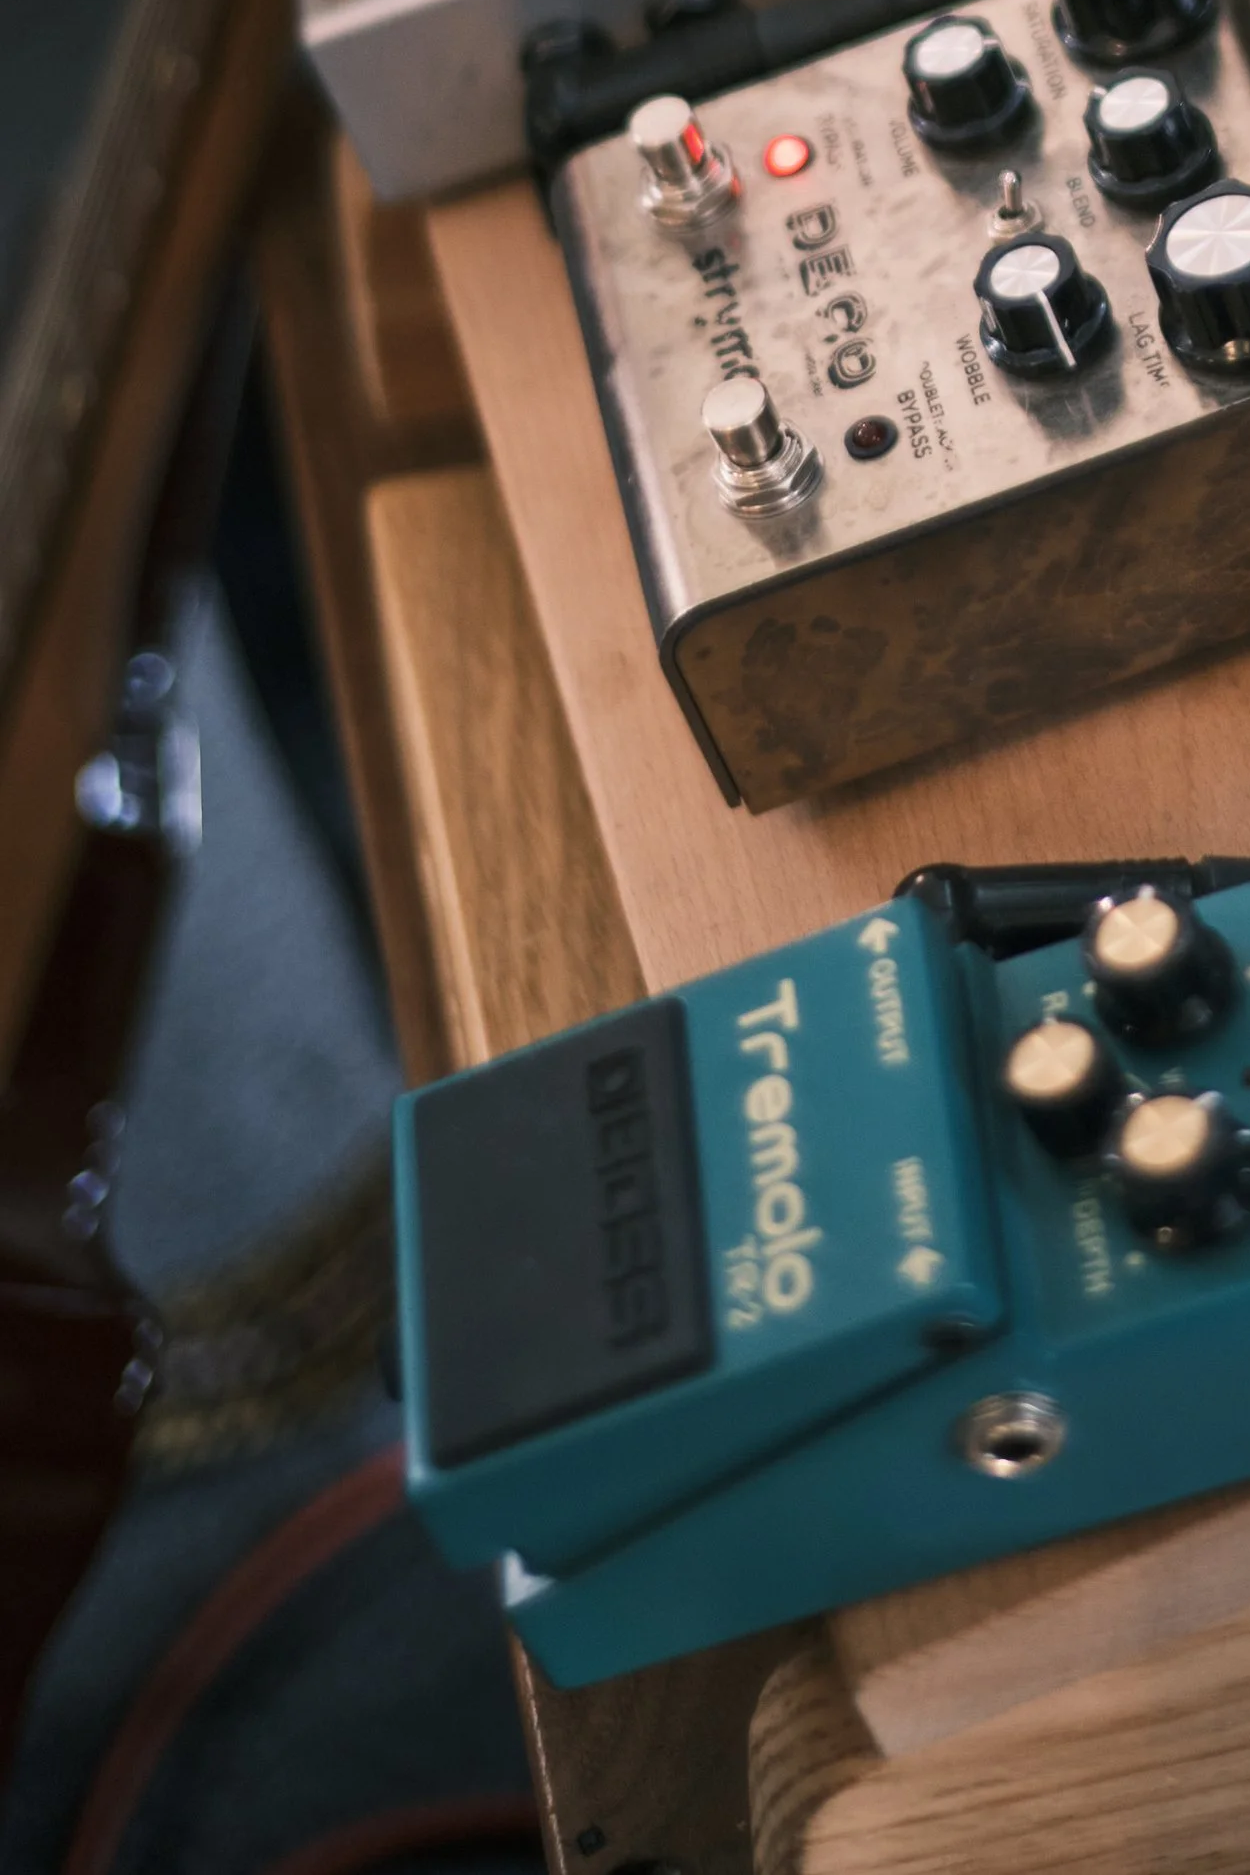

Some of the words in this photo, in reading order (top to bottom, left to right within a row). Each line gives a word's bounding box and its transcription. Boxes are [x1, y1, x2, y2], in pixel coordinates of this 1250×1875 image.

[1022, 0, 1069, 102] SATURATION
[1066, 176, 1096, 228] BLEND
[785, 200, 878, 391] DECO
[1128, 311, 1155, 349] LAG
[956, 333, 992, 407] WOBBLE
[897, 387, 933, 459] BYPASS
[868, 957, 910, 1065] OUTPUT
[737, 978, 823, 1315] Tremolo
[1073, 1198, 1114, 1297] DEPTH
